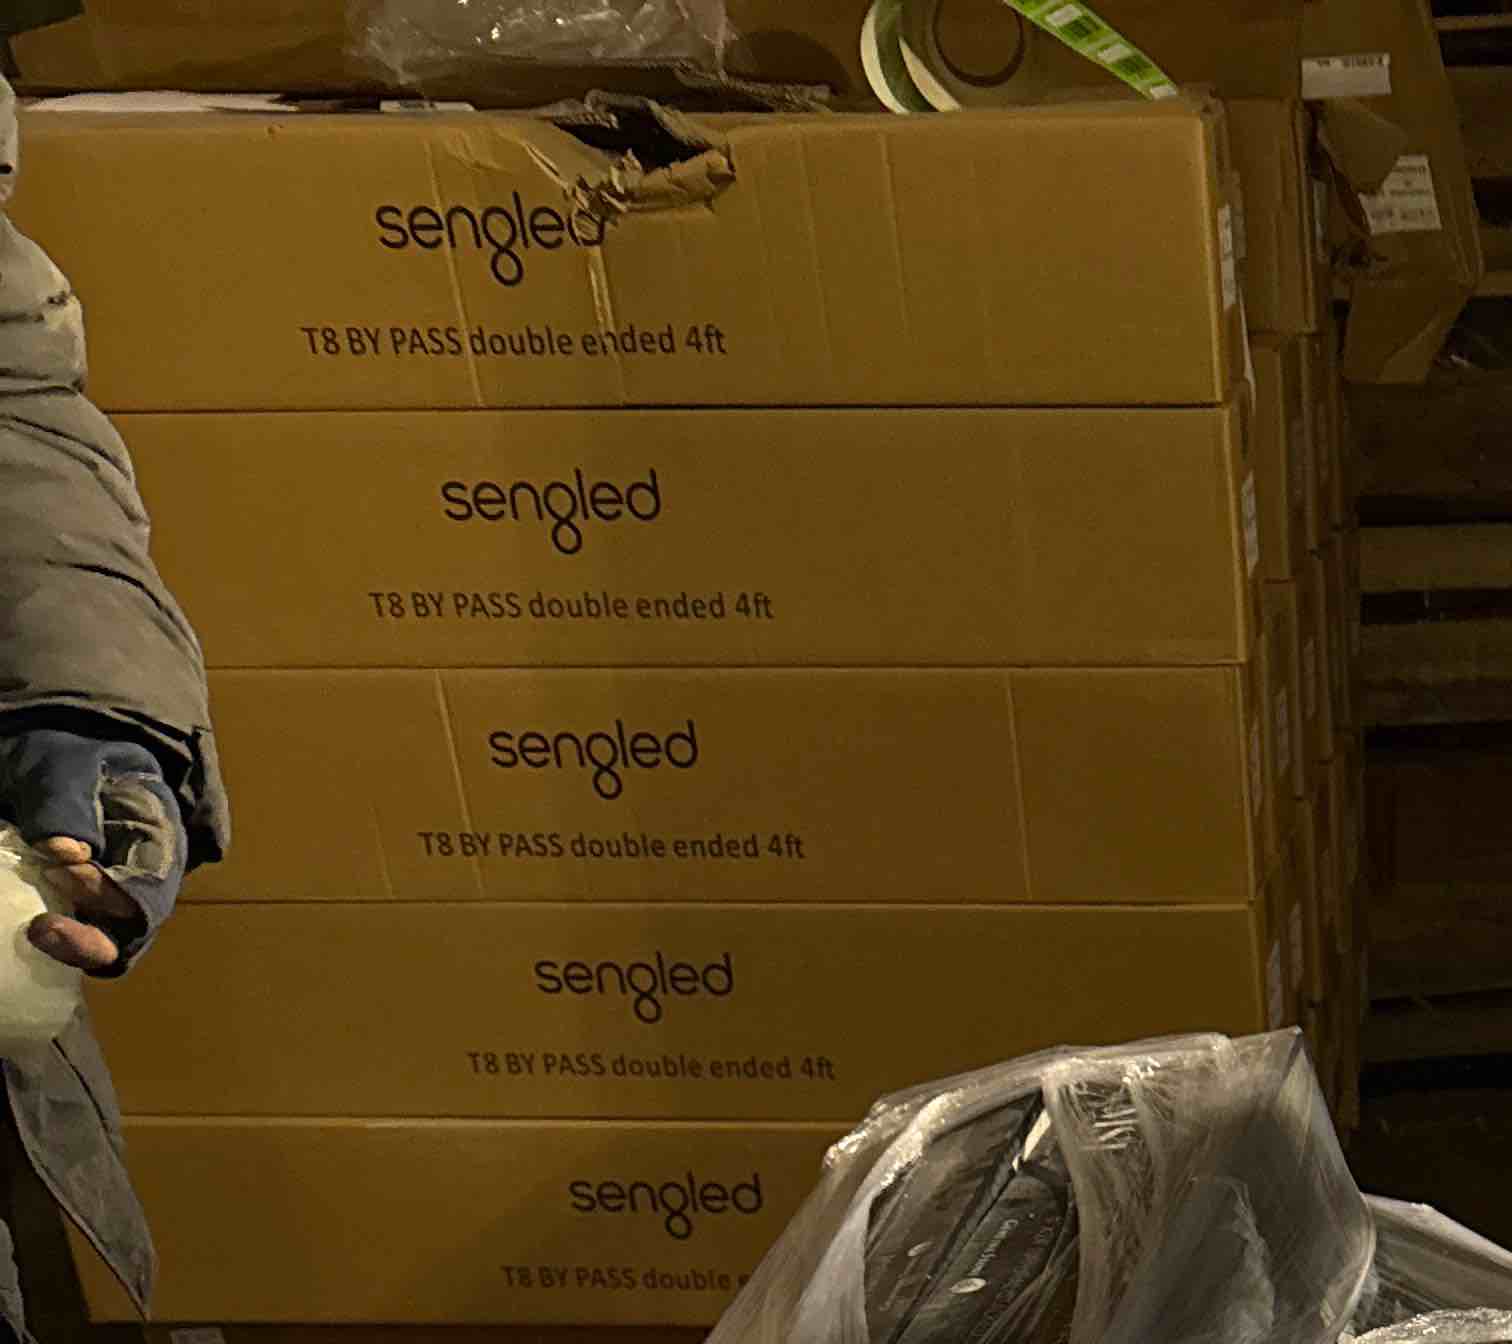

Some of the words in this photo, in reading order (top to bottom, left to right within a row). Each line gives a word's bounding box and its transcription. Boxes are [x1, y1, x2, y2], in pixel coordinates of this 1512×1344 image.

[376, 192, 605, 286] sengled
[302, 326, 341, 355] T8
[349, 327, 381, 355] BY
[392, 326, 463, 356] PASS
[469, 325, 574, 357] double
[581, 326, 676, 356] ended
[684, 325, 727, 357] 4ft
[441, 467, 662, 554] sengled
[370, 592, 405, 619] T8
[412, 592, 448, 619] BY
[453, 592, 523, 620] PASS
[528, 591, 630, 621] double
[636, 592, 727, 621] ended
[733, 592, 775, 621] 4ft
[488, 719, 698, 800] sengled
[417, 832, 455, 858] T8
[460, 832, 490, 858] BY
[499, 832, 563, 859] PASS
[570, 832, 665, 859] double
[673, 833, 760, 860] ended
[766, 834, 806, 861] 4ft
[534, 951, 734, 1025] sengled
[467, 1052, 499, 1076] T8
[506, 1052, 535, 1076] BY
[542, 1053, 606, 1077] PASS
[611, 1053, 701, 1079] double
[708, 1054, 792, 1081] ended
[799, 1055, 836, 1082] 4ft
[568, 1171, 763, 1240] sengled
[501, 1265, 535, 1288] T8
[540, 1266, 568, 1288] BY
[573, 1266, 636, 1290] PASS
[641, 1265, 732, 1292] double
